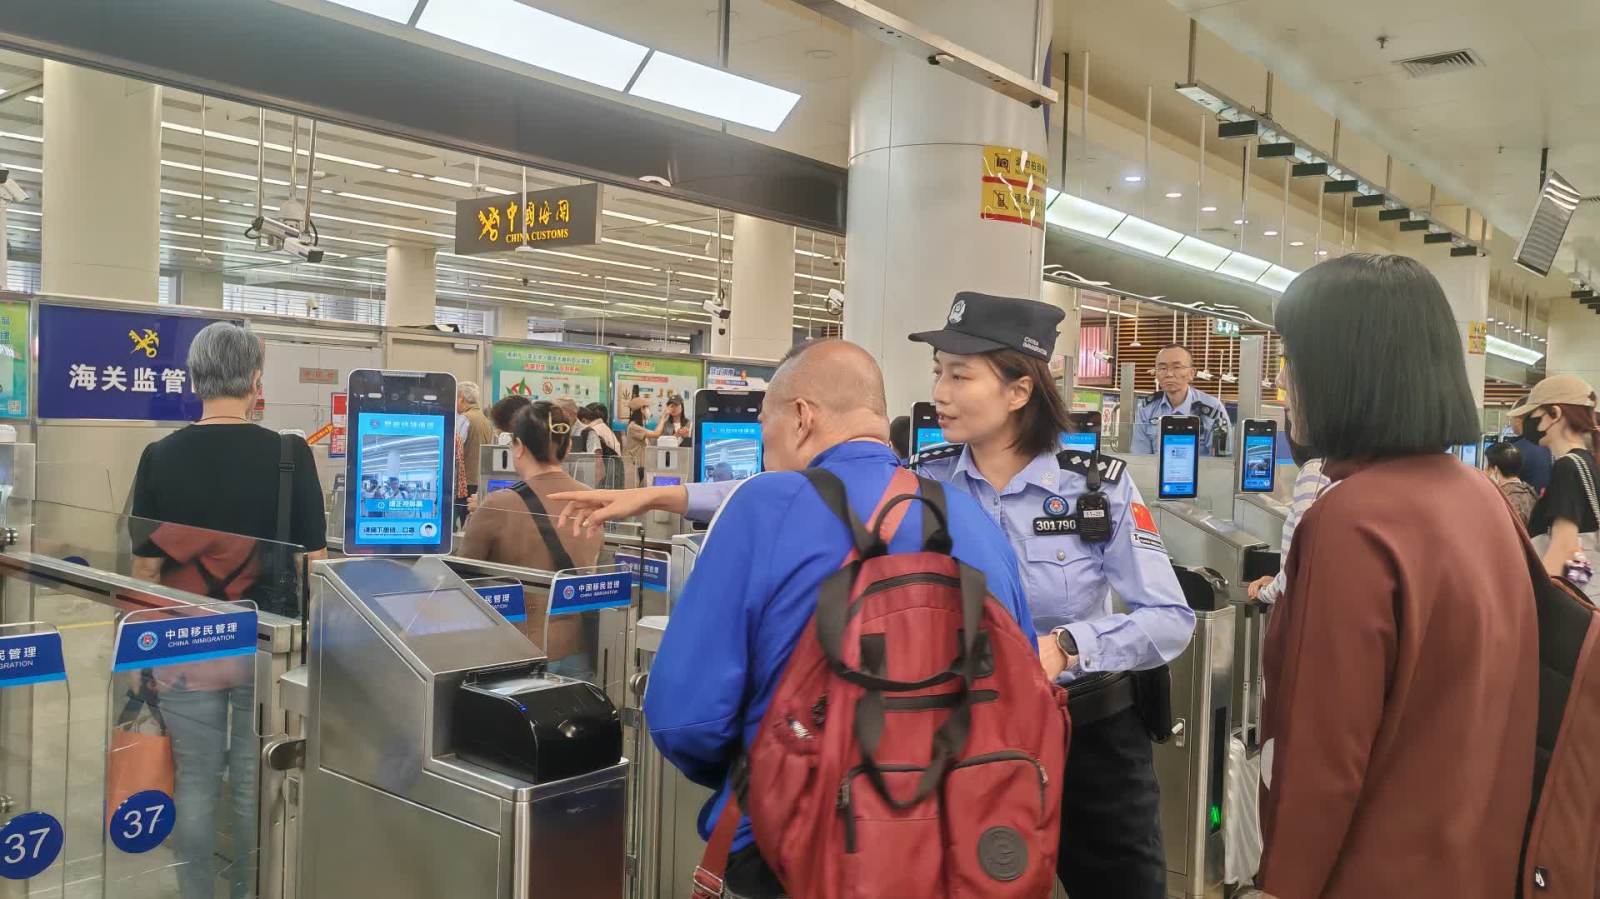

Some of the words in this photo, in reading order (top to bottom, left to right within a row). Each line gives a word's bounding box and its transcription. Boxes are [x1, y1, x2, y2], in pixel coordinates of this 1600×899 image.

[506, 232, 530, 243] CHINA
[532, 229, 569, 240] CUSTOMS
[68, 363, 196, 394] 海关监管
[1036, 519, 1077, 531] 301790
[578, 580, 620, 593] 中国移民管理
[165, 622, 238, 641] 中国移民管理
[168, 639, 189, 648] CHINA
[191, 634, 235, 645] IMMIGRATION
[123, 804, 165, 839] 37
[4, 827, 51, 864] 37
